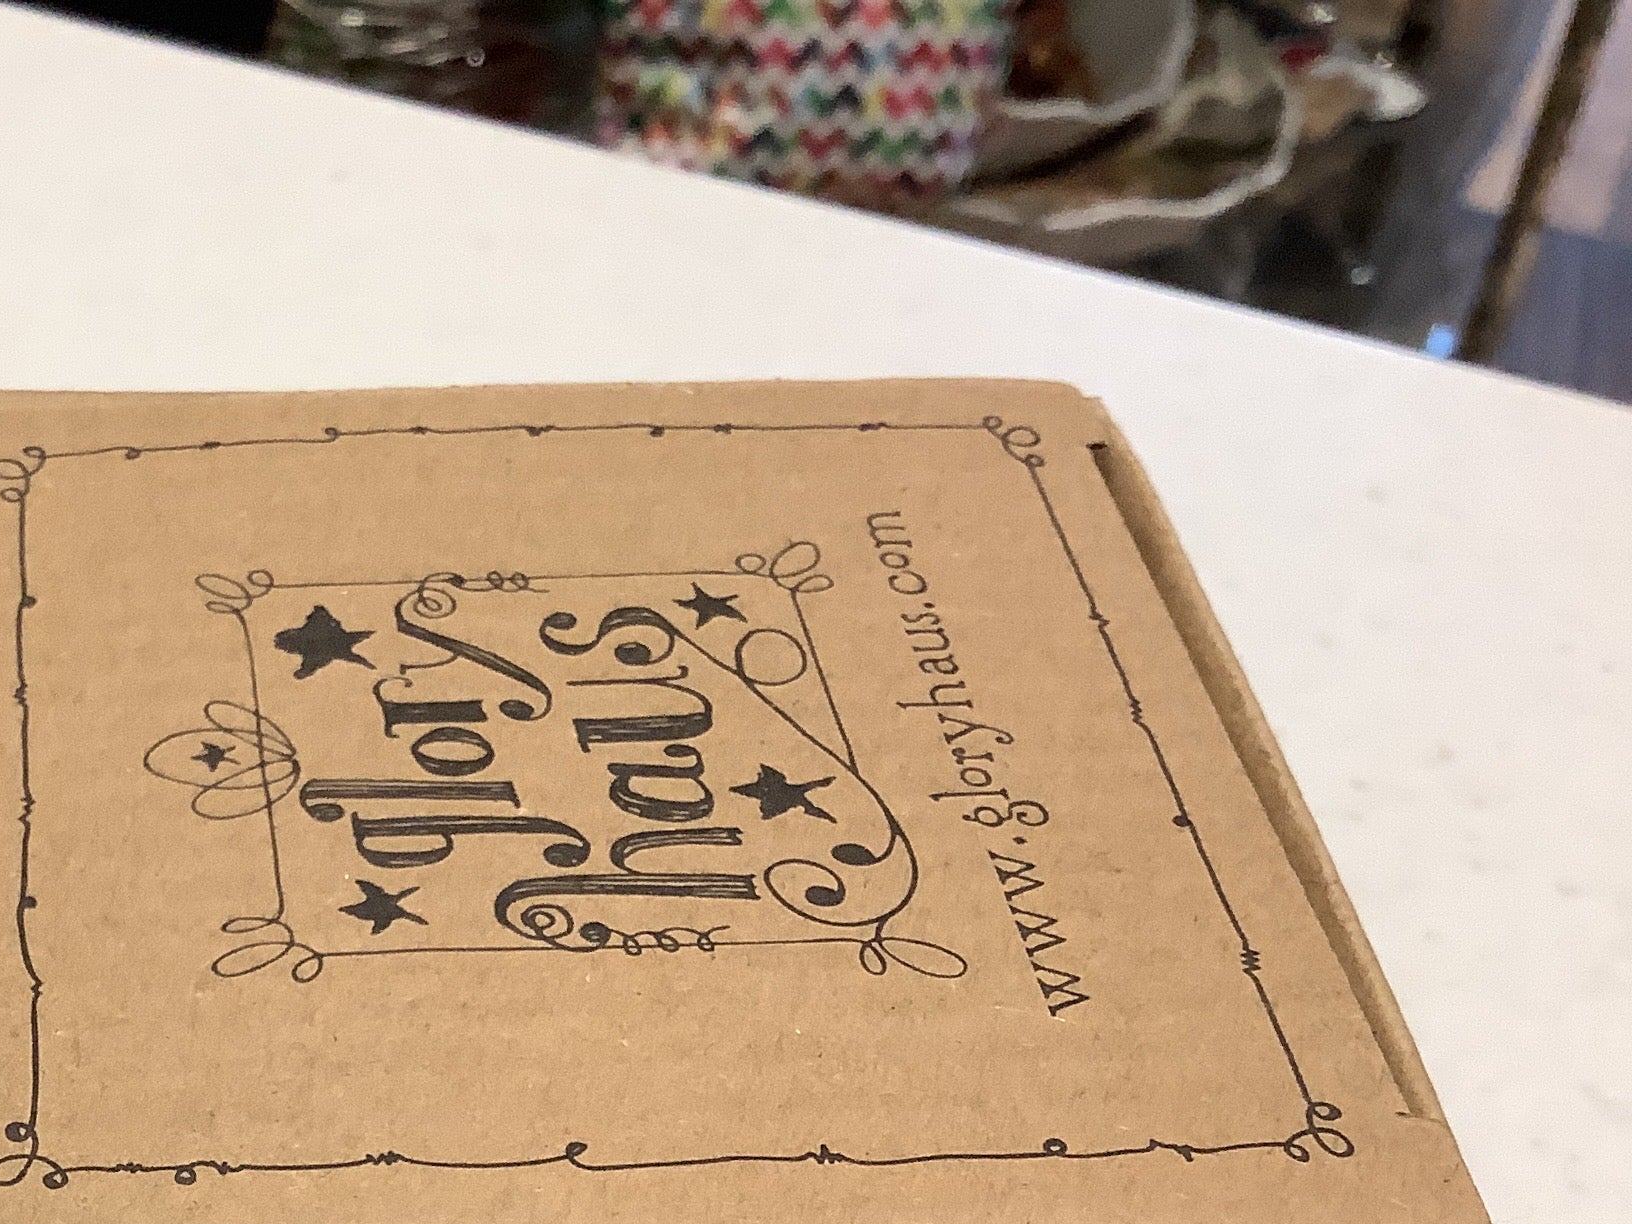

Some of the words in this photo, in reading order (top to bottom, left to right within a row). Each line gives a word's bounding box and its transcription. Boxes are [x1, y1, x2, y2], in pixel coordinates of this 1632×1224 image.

[299, 586, 590, 868] glory
[495, 606, 761, 950] haus
[867, 510, 1090, 1017] www.gloryhaus.com
